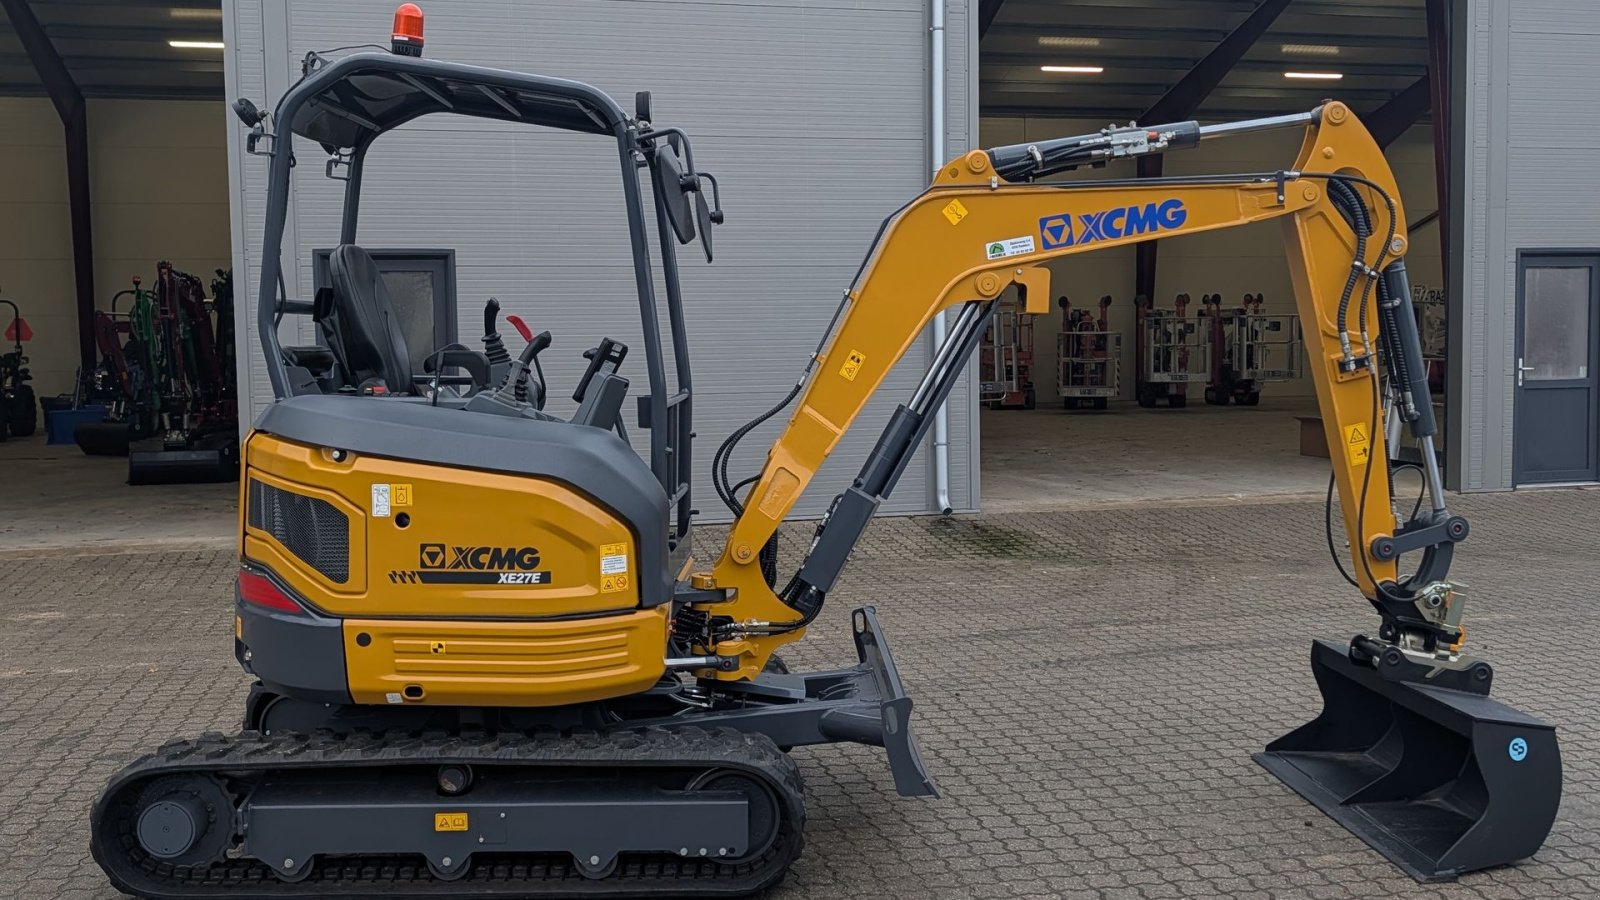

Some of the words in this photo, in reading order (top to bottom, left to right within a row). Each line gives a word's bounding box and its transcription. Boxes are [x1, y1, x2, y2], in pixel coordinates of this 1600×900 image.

[1076, 199, 1187, 244] XCMG
[447, 547, 541, 570] XCMG
[497, 573, 541, 584] XE27E
